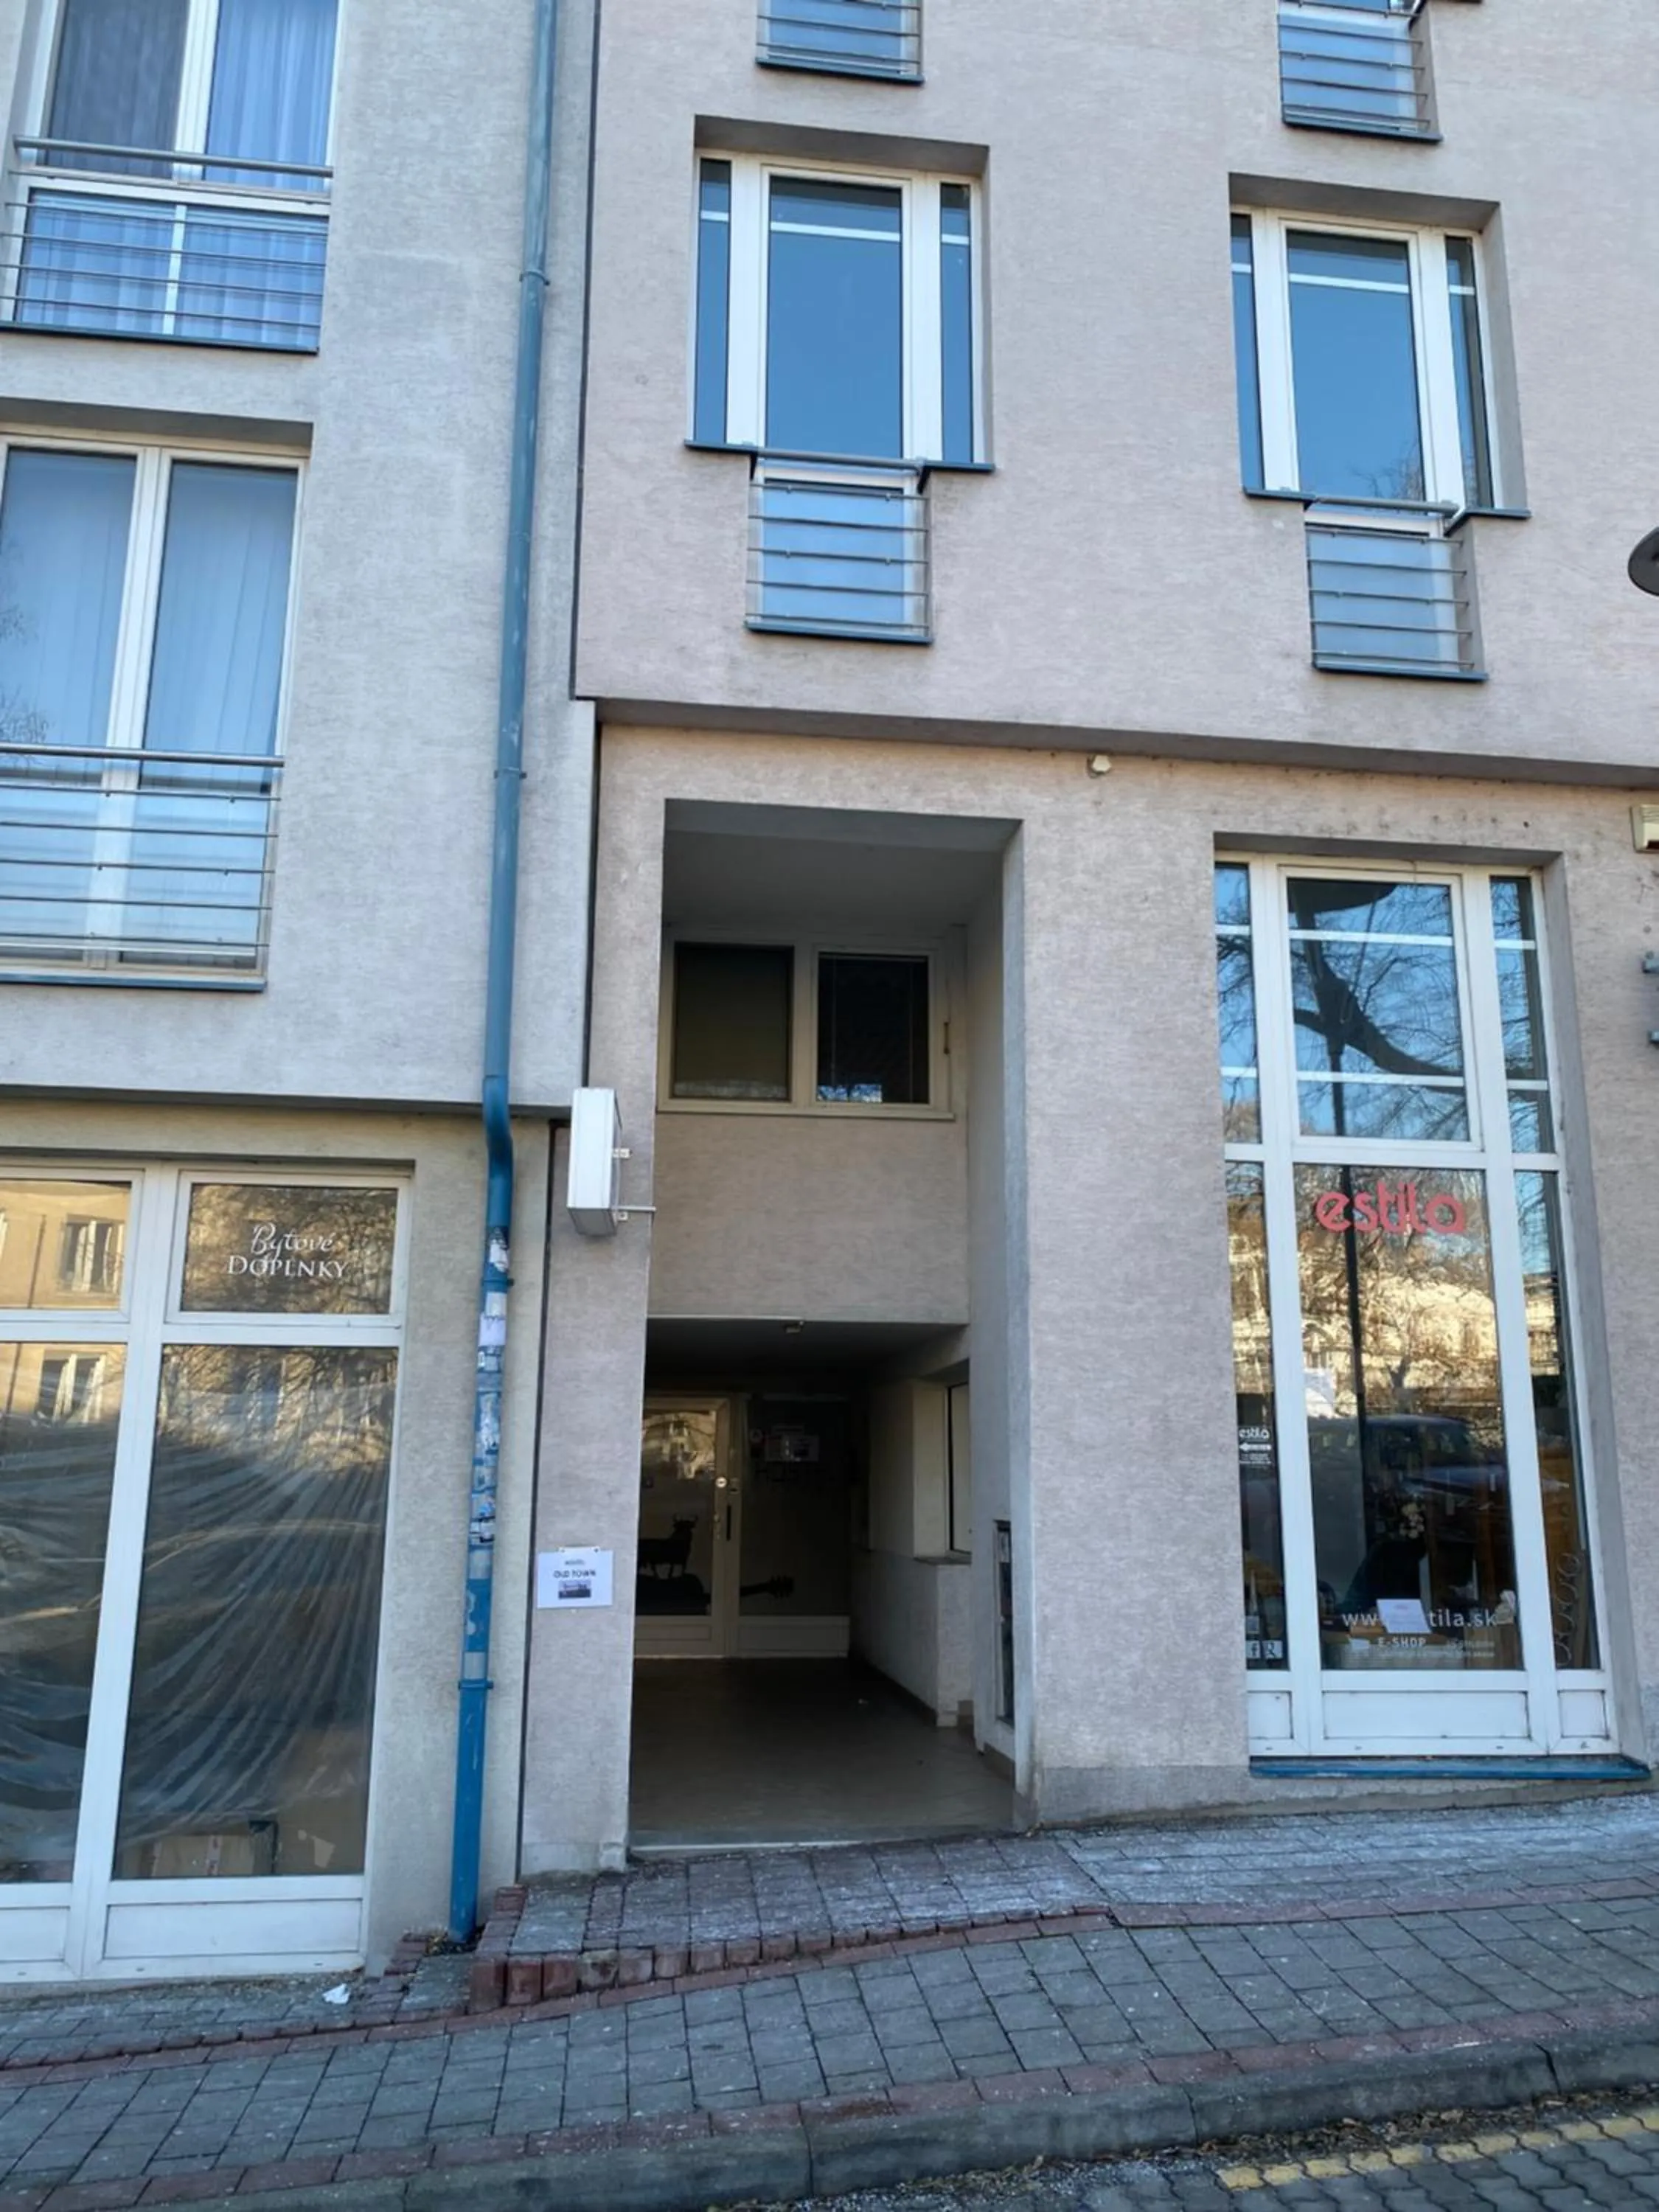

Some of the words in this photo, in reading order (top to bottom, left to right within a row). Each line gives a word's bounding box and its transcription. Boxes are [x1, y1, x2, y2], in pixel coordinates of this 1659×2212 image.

[1315, 1180, 1464, 1234] estila
[250, 1221, 336, 1262] Bytové
[227, 1254, 350, 1278] DOPLNKY
[1378, 1636, 1427, 1649] E-SHOP
